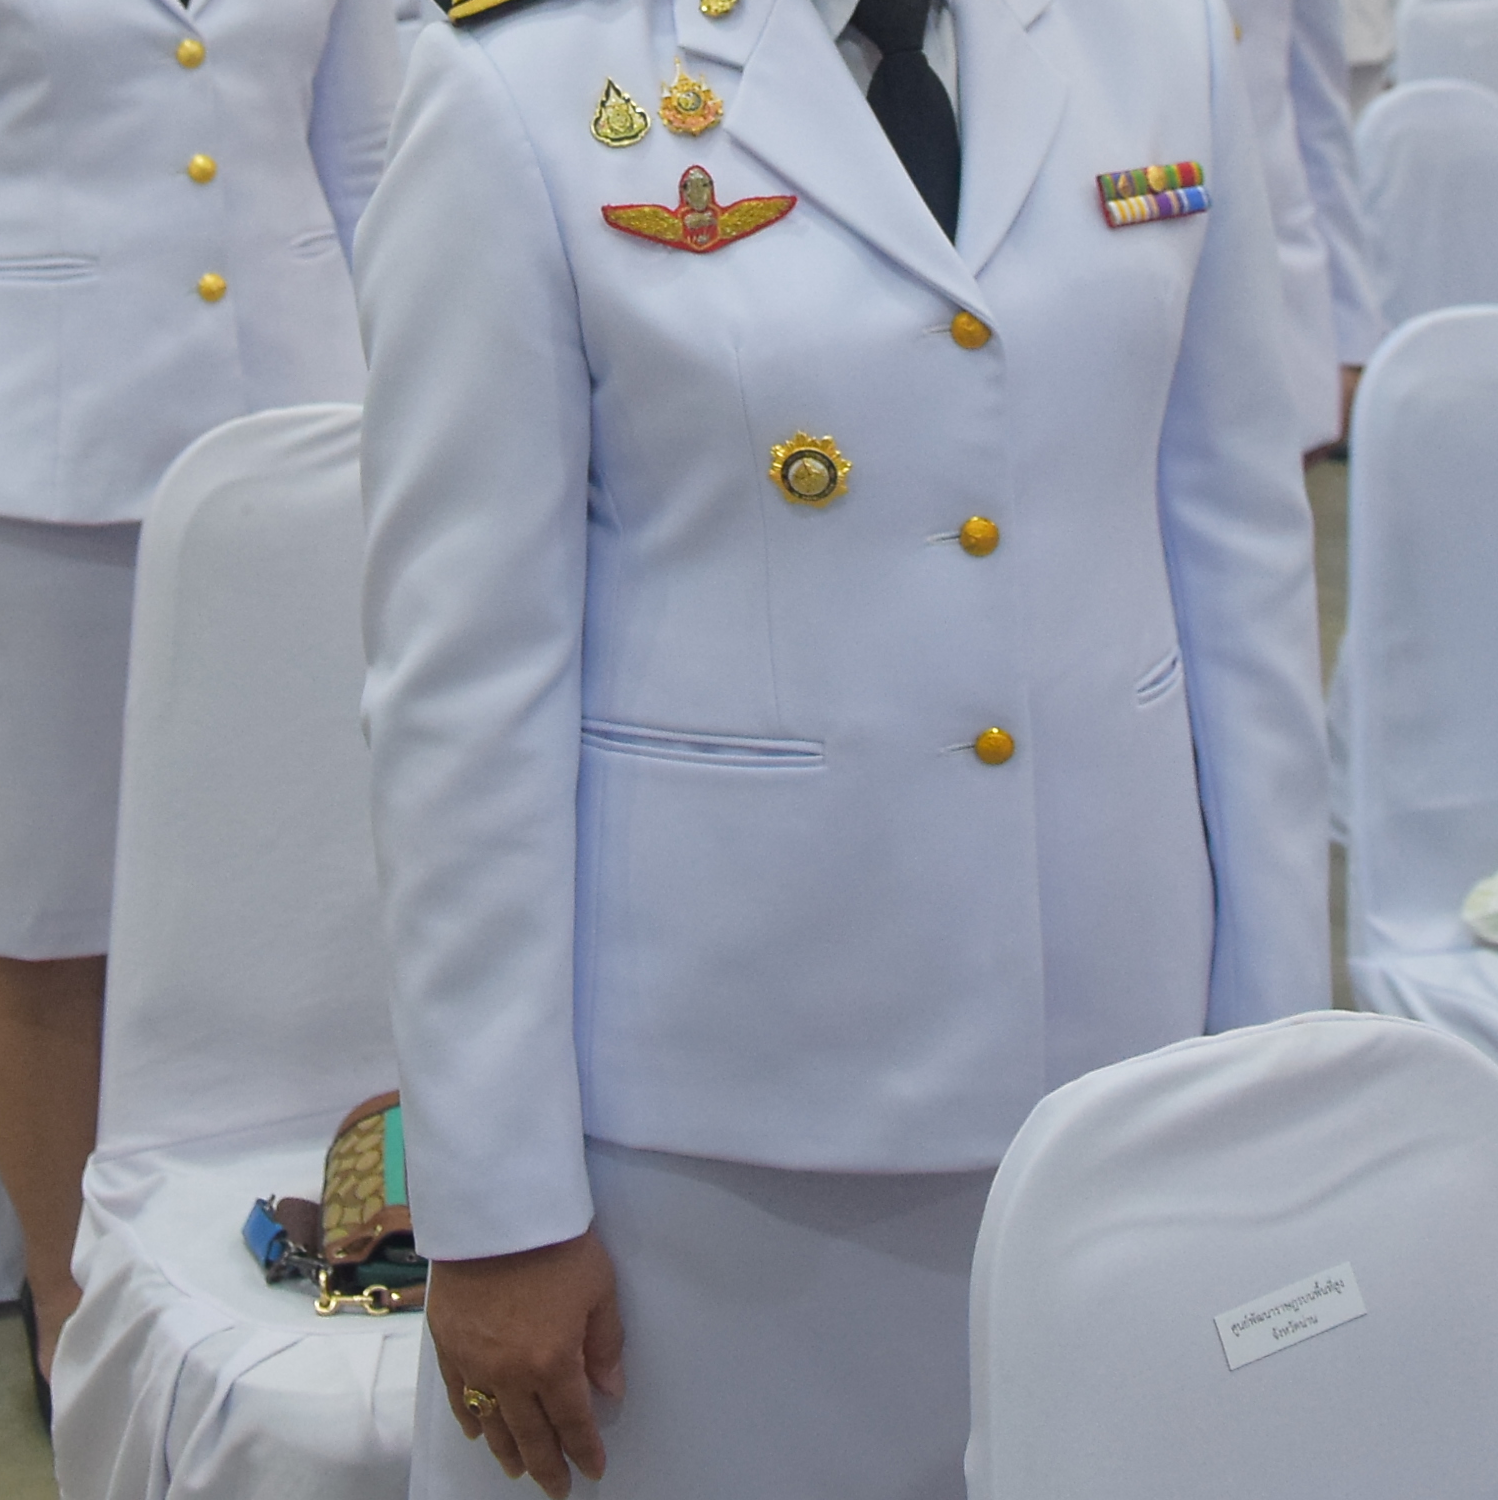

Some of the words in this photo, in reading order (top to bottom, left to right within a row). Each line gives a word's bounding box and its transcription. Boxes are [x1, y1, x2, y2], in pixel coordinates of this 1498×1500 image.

[1272, 1315, 1319, 1340] จังหวัดน่าน
